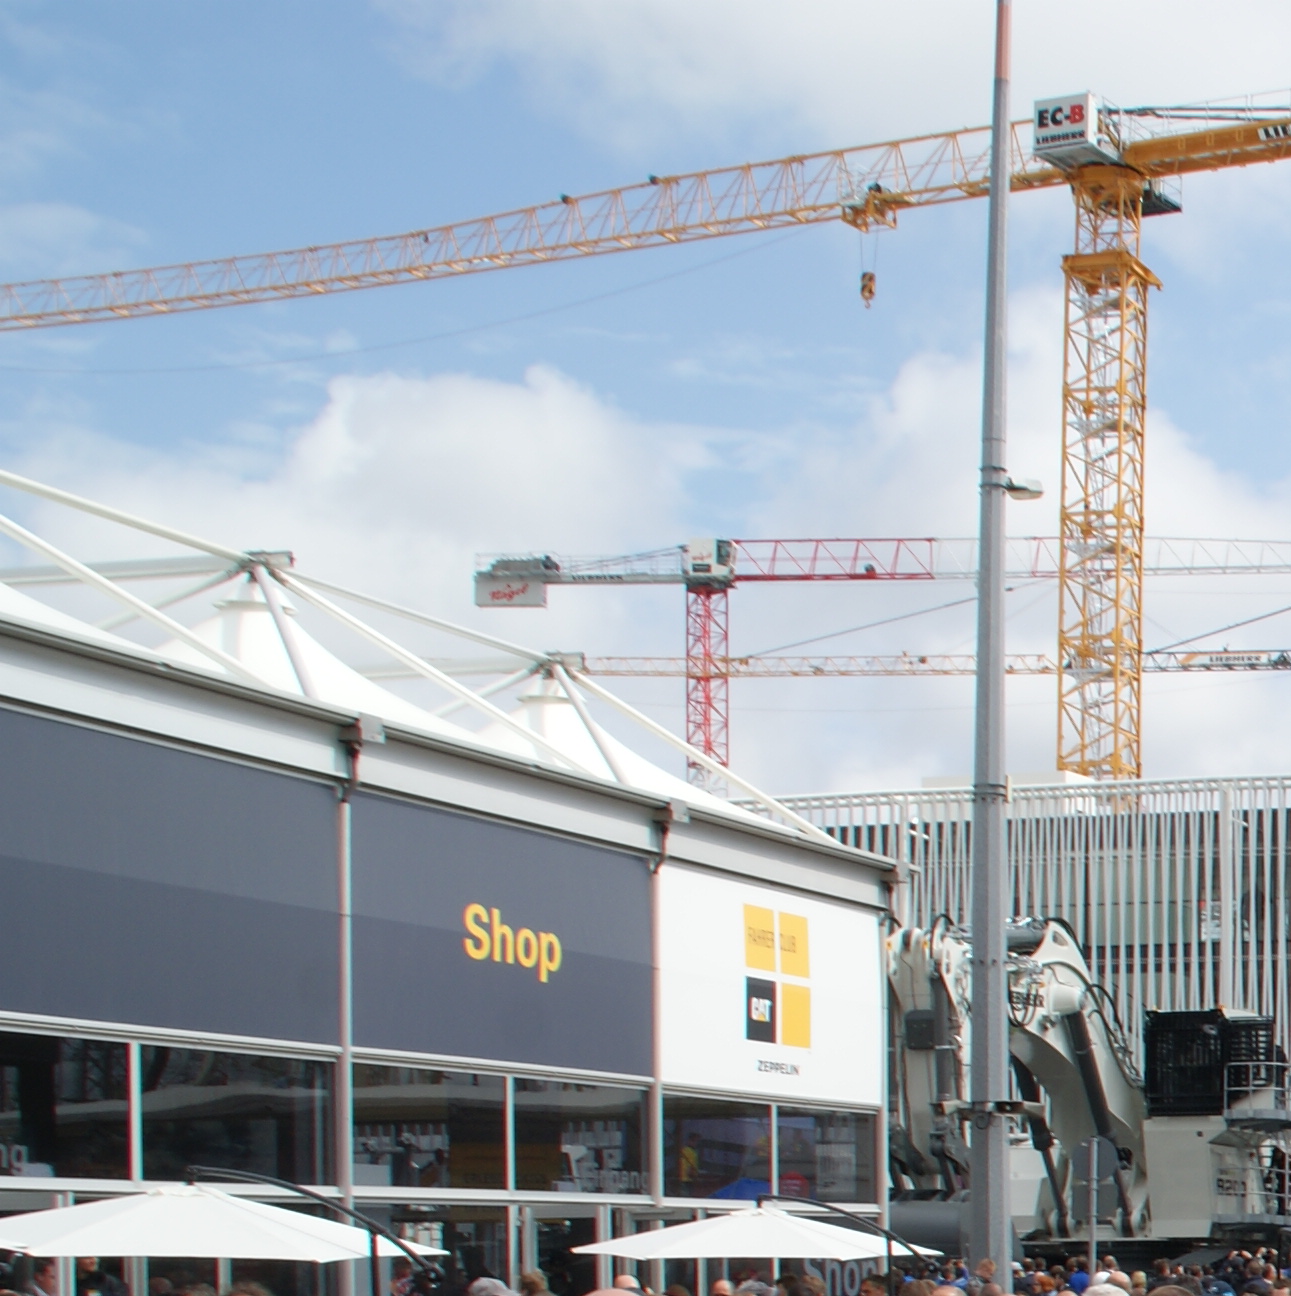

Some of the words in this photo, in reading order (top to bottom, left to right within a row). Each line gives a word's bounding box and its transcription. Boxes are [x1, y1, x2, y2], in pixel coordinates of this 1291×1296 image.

[1037, 104, 1085, 128] EC-B
[1035, 130, 1086, 145] LIEBHERR
[1209, 655, 1262, 663] LIEBHERR
[463, 903, 562, 983] Shop
[750, 997, 772, 1022] CAT
[757, 1060, 801, 1076] ZEPPELIN
